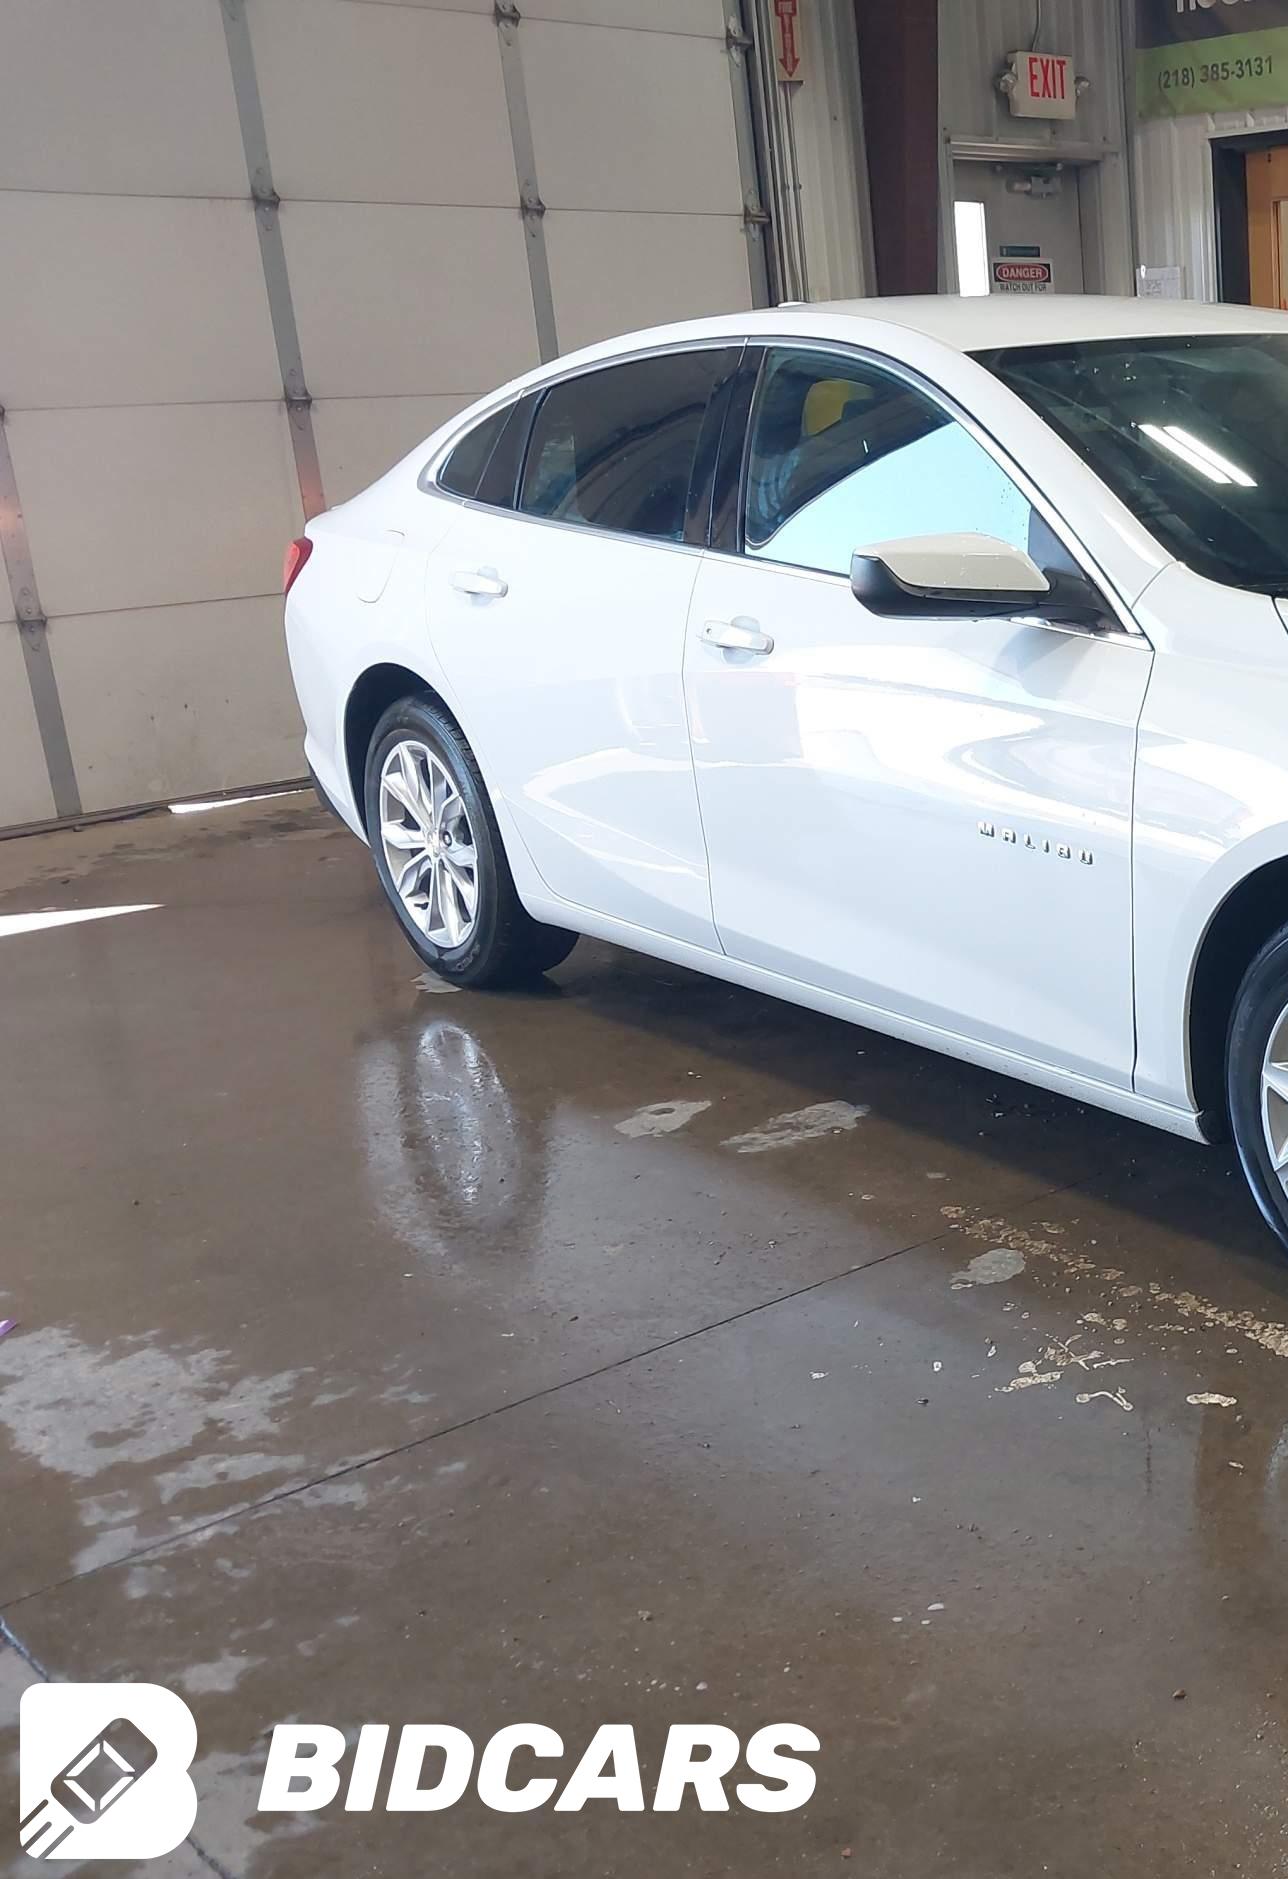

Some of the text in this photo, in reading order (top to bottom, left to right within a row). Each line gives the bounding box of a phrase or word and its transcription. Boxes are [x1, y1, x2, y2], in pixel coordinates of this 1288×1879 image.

[1028, 56, 1066, 100] EXIT
[1158, 56, 1274, 90] (218) 385-3131
[1002, 268, 1042, 278] DANGER
[977, 821, 1094, 866] MALIBU
